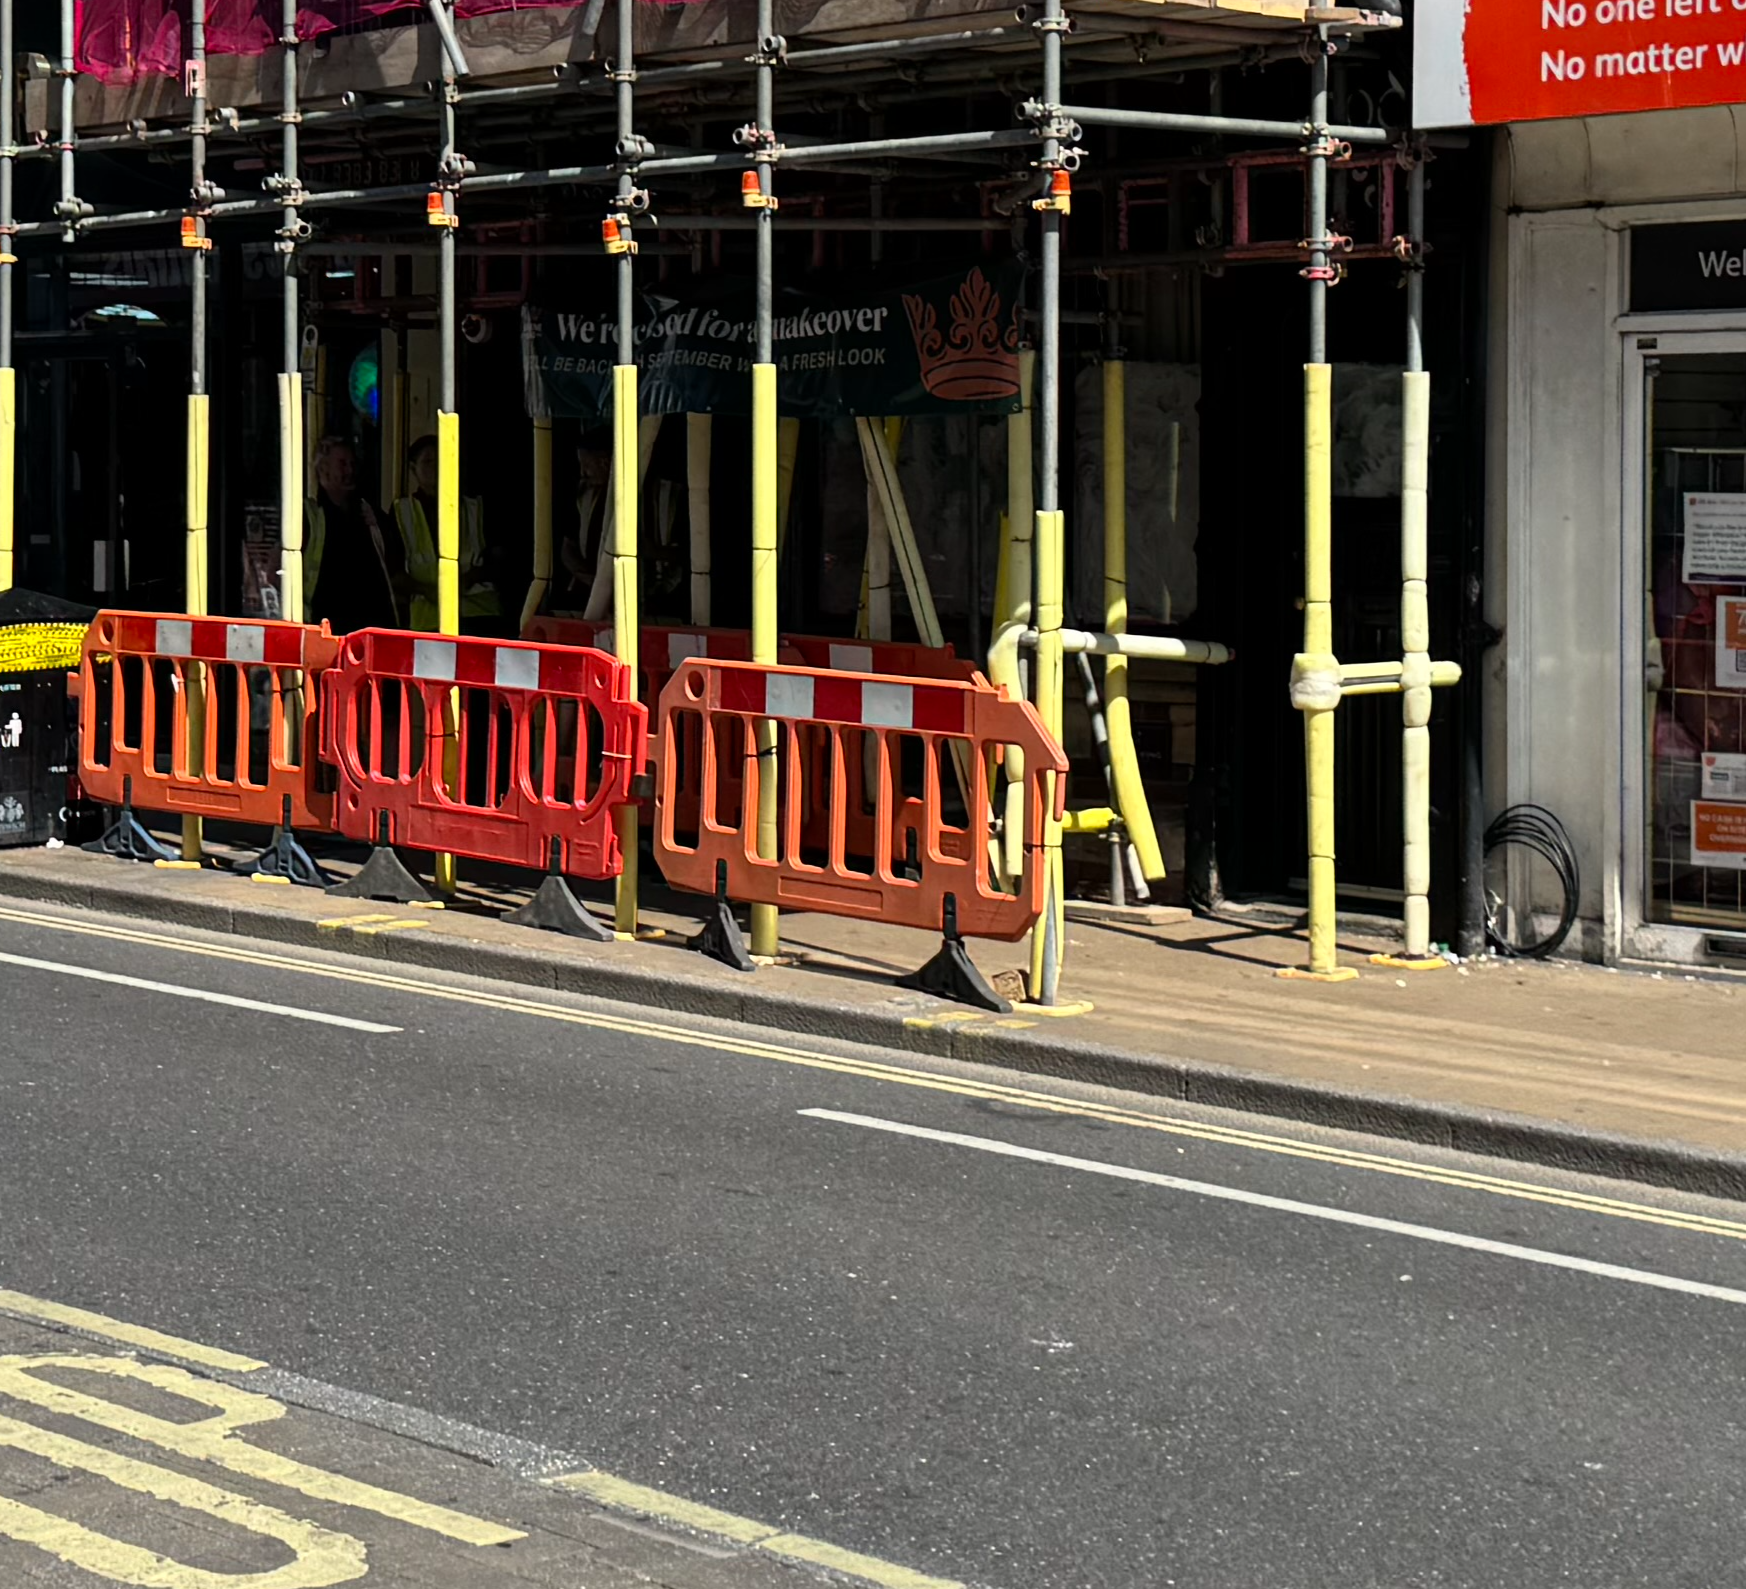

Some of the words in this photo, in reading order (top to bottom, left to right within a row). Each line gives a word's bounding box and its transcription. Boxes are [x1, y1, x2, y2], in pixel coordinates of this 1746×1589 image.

[1541, 49, 1586, 82] No
[1595, 41, 1710, 77] matter
[696, 308, 745, 344] for
[553, 356, 575, 373] BE
[792, 350, 836, 372] FRESH
[838, 347, 887, 367] LOOK
